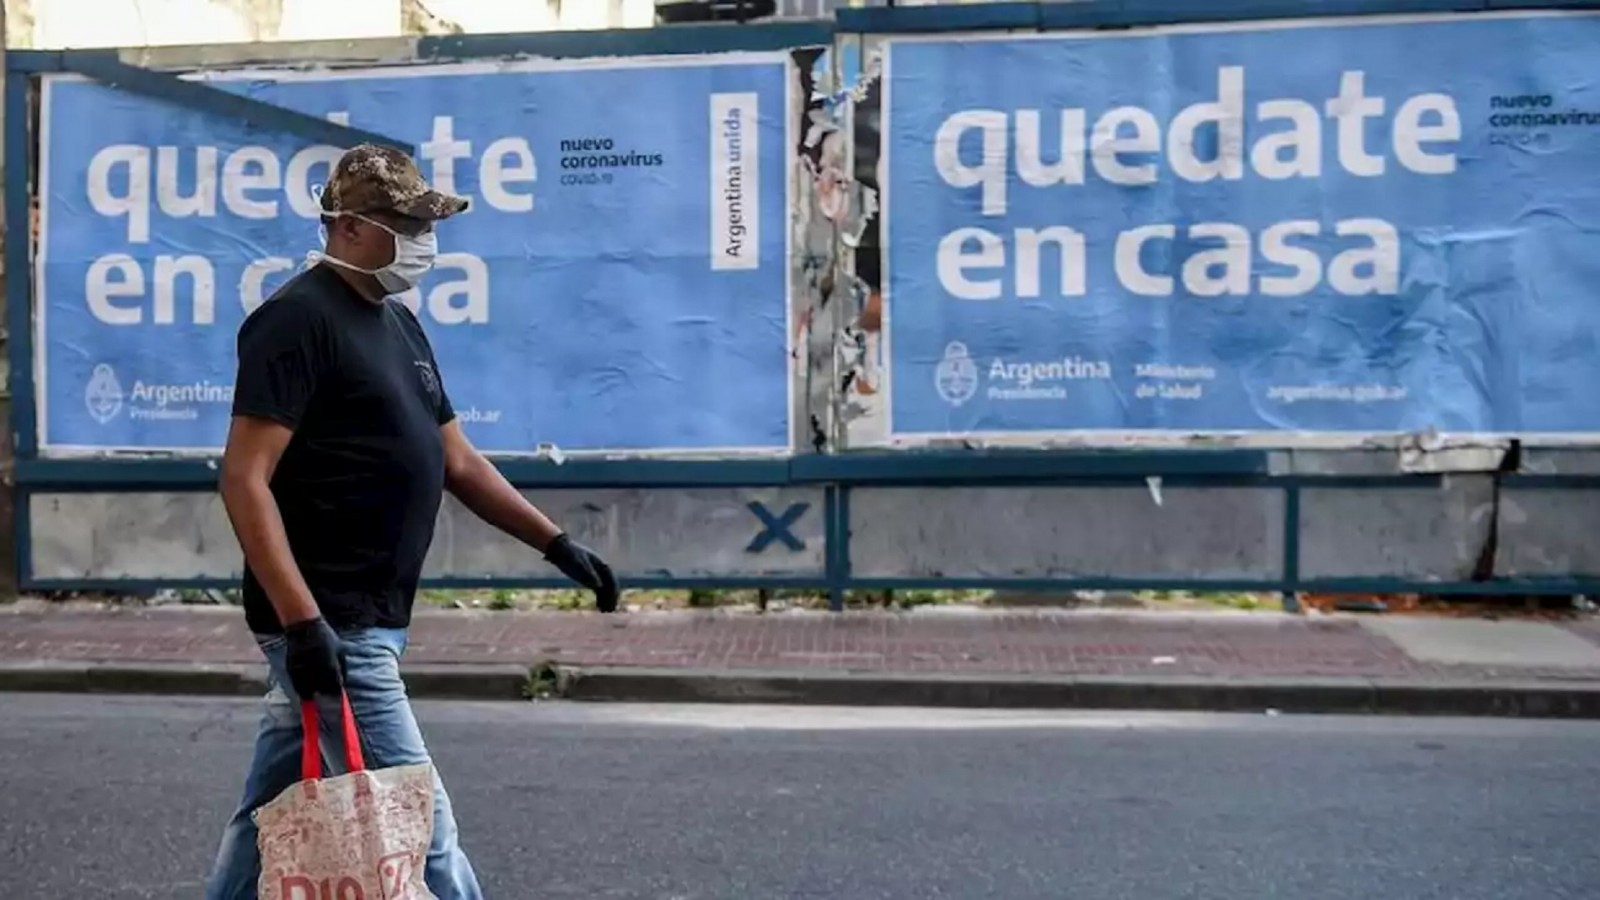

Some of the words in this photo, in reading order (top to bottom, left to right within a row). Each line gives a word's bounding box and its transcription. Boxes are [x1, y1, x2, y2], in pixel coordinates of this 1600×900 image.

[1490, 95, 1553, 109] nuevo
[1490, 109, 1600, 127] coronaviru
[560, 138, 614, 151] nuevo
[724, 107, 742, 163] unida
[934, 65, 1462, 216] quedate
[86, 111, 539, 243] quedte
[560, 149, 663, 169] coronavirus
[726, 165, 747, 258] Argentina
[936, 226, 1086, 300] en
[1115, 216, 1399, 298] casa
[85, 252, 215, 325] en
[239, 251, 490, 325] ca
[988, 355, 1111, 386] Argentina
[131, 379, 233, 407] Argentina
